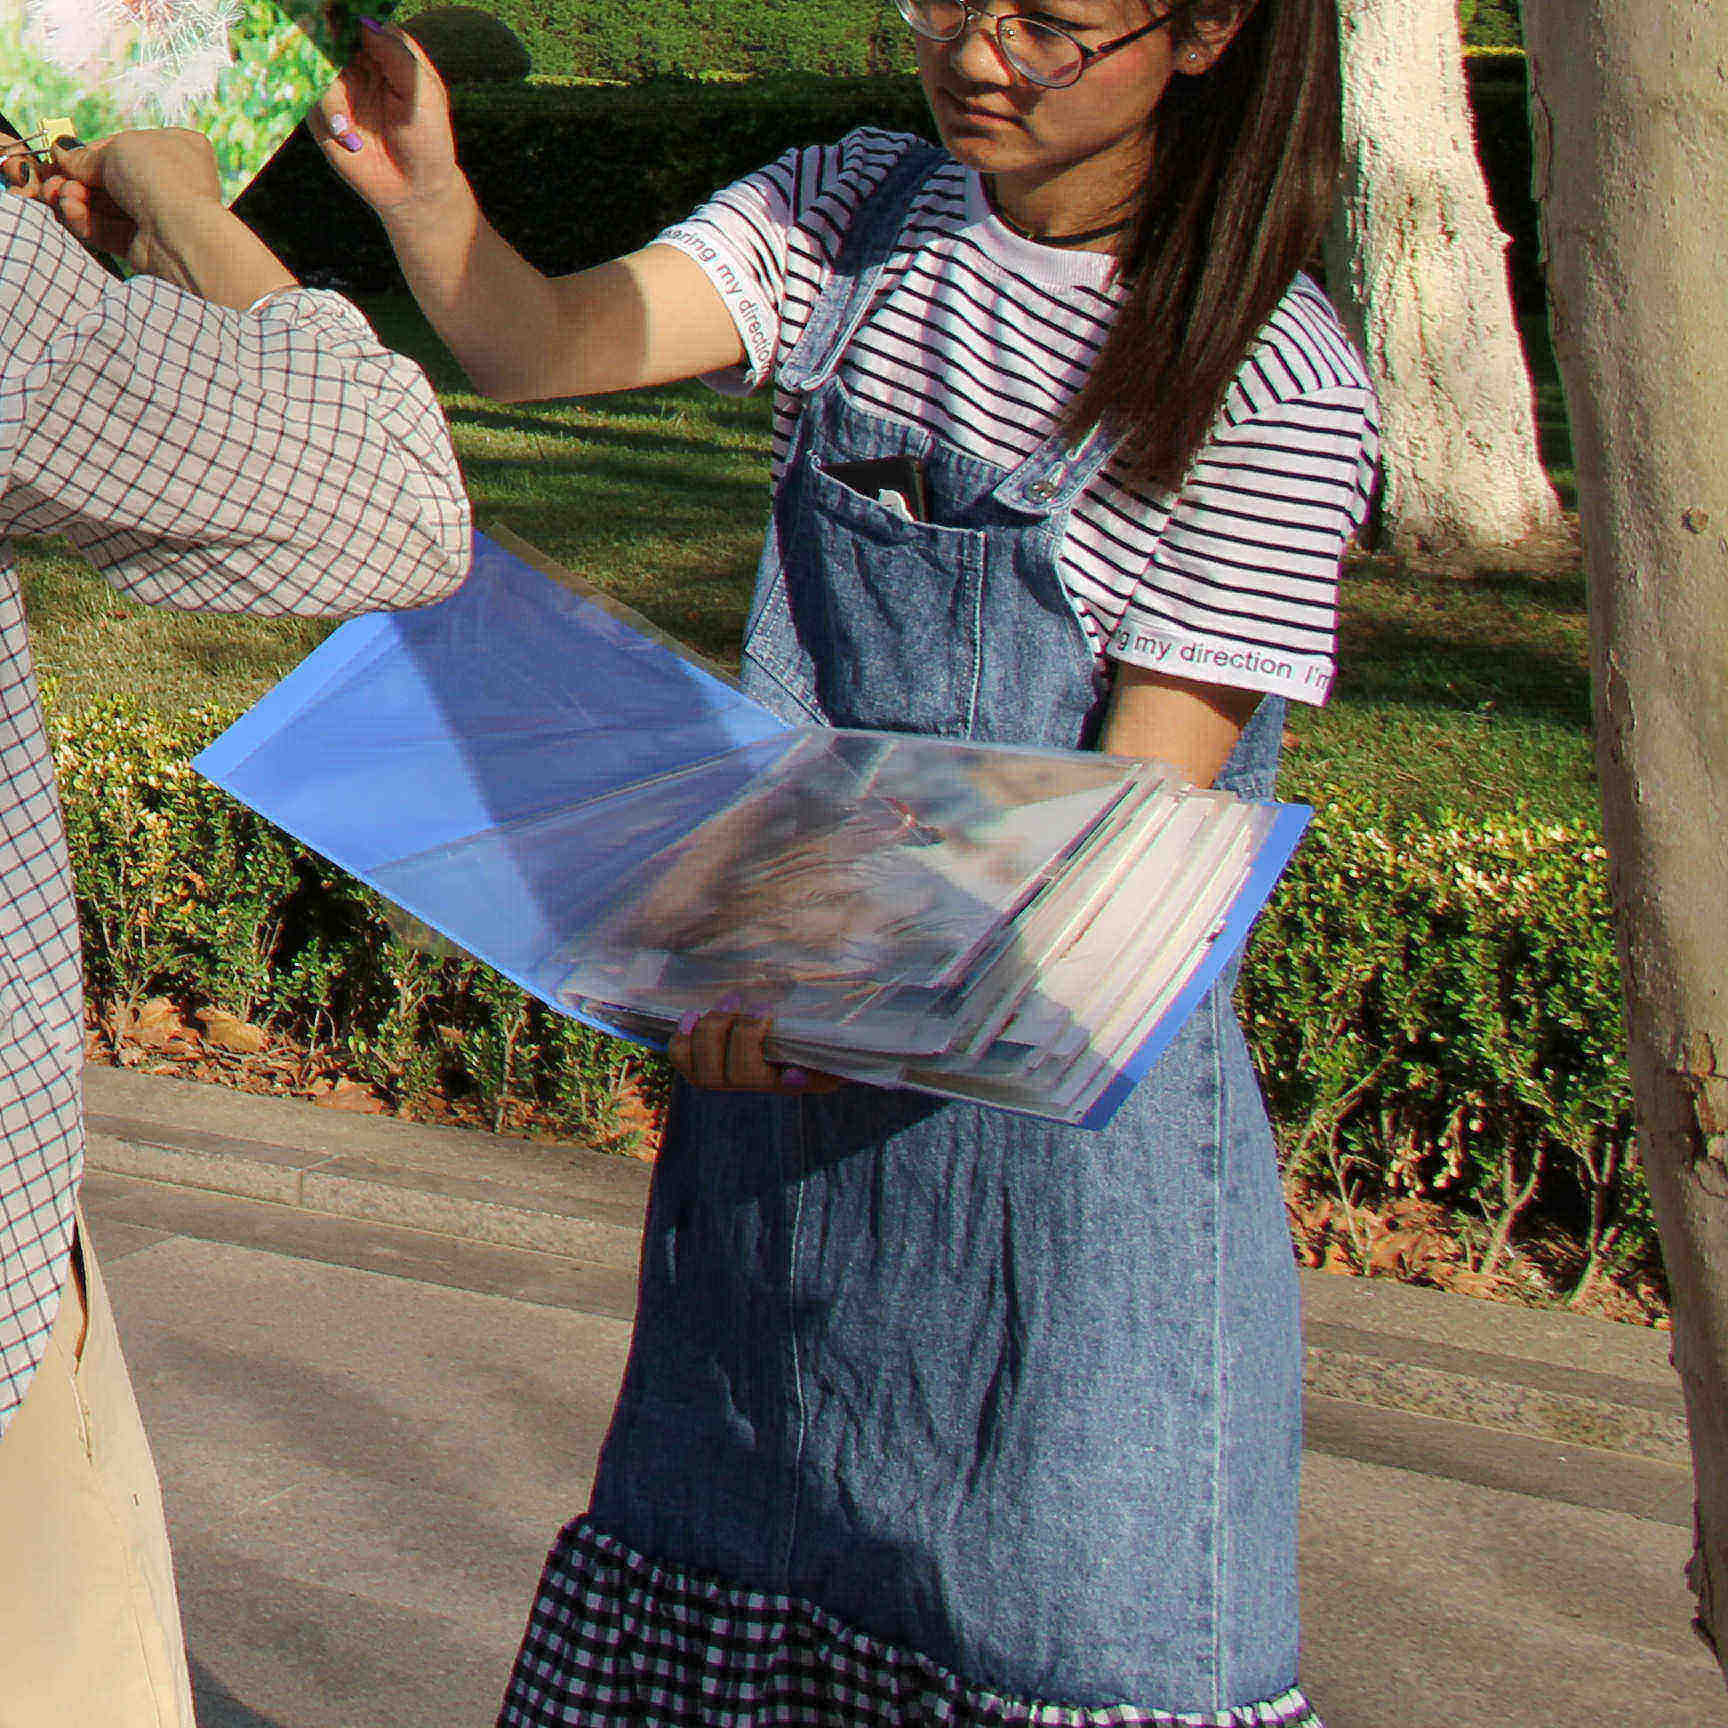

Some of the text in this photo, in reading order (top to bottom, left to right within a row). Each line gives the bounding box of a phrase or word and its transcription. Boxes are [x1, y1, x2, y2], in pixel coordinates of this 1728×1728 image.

[717, 264, 743, 295] my
[1135, 635, 1173, 661] my
[1180, 642, 1293, 679] direction
